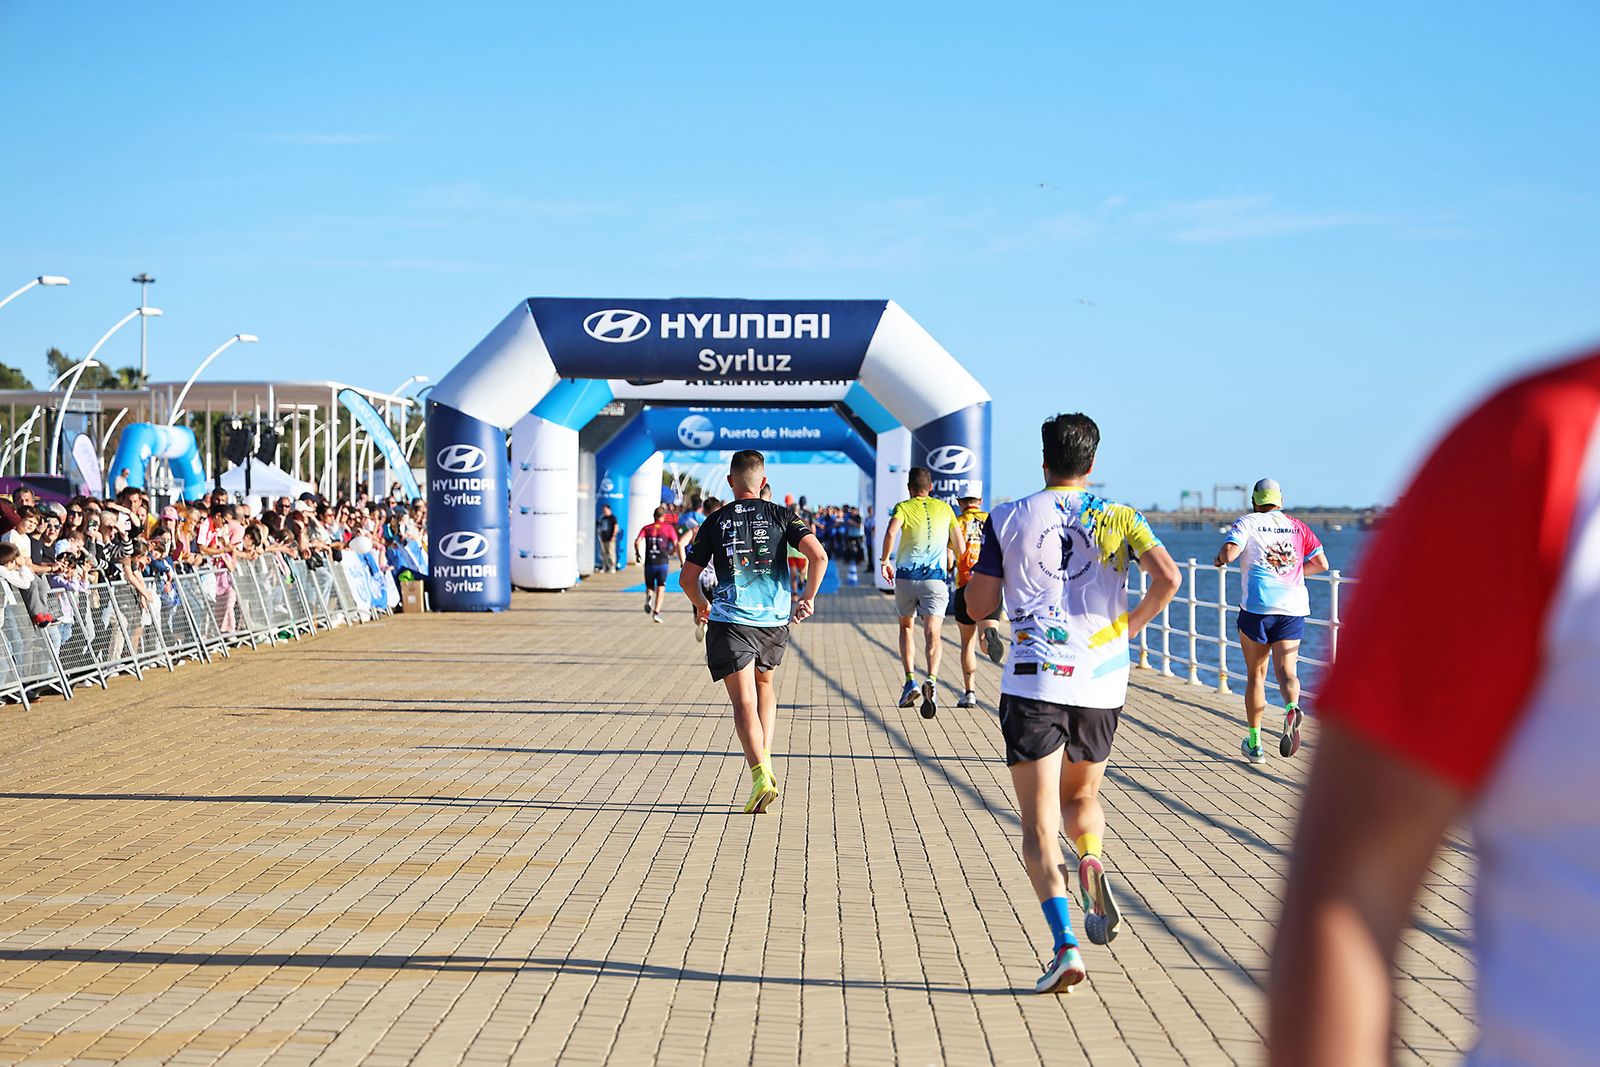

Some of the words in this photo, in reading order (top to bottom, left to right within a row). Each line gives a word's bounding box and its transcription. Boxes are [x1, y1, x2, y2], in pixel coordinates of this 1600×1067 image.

[660, 313, 831, 339] HYUNDAI
[698, 348, 792, 375] Syrluz
[720, 426, 759, 439] Puerto
[761, 426, 777, 439] de
[780, 426, 821, 439] Huelva
[432, 478, 495, 491] HYUNDAI
[443, 493, 482, 507] Syrluz
[1036, 534, 1045, 549] CLUB
[434, 564, 497, 578] HYUNDAI
[445, 580, 483, 594] Syrluz
